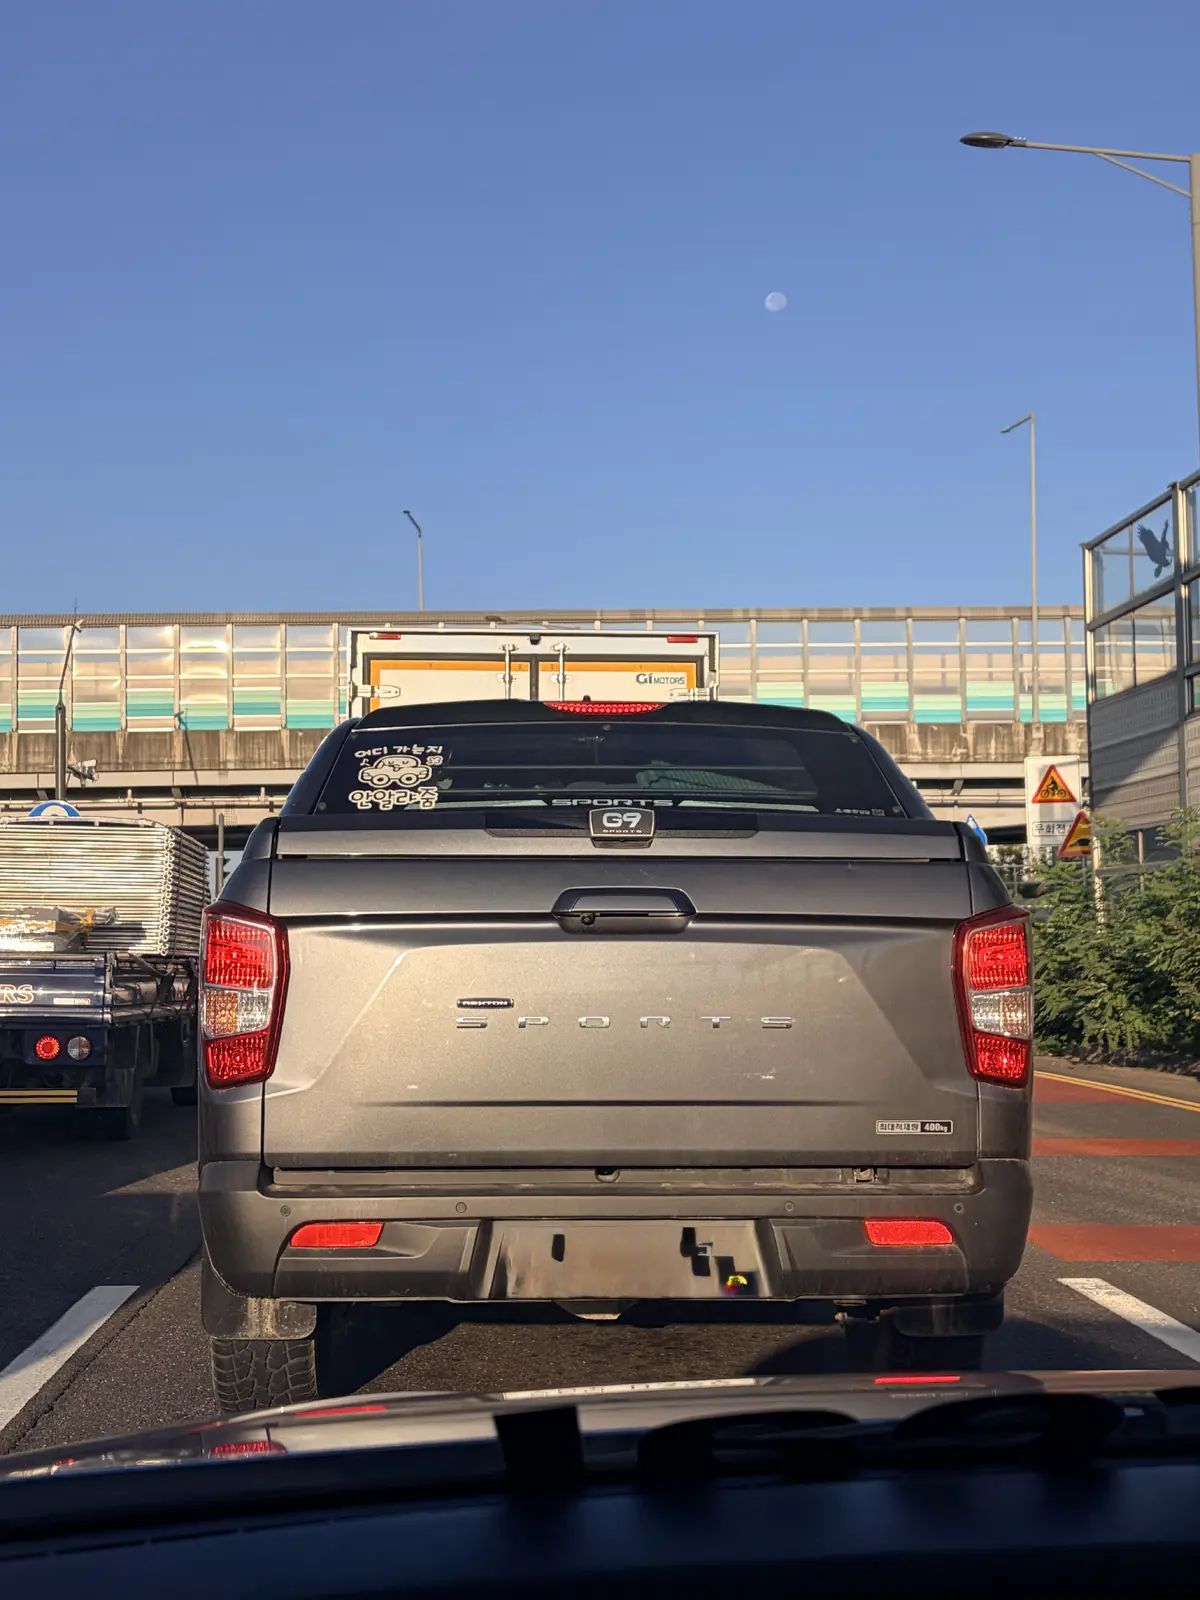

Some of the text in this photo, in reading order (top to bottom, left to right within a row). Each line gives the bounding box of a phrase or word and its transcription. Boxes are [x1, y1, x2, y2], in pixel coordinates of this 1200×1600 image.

[354, 744, 443, 758] 어디 가는지
[348, 786, 438, 811] 안알랴줌
[551, 798, 673, 807] SPORTS
[602, 812, 642, 828] G9
[1034, 823, 1066, 835] 우회전
[455, 1016, 793, 1029] SPORTS
[924, 1122, 948, 1132] 400kg
